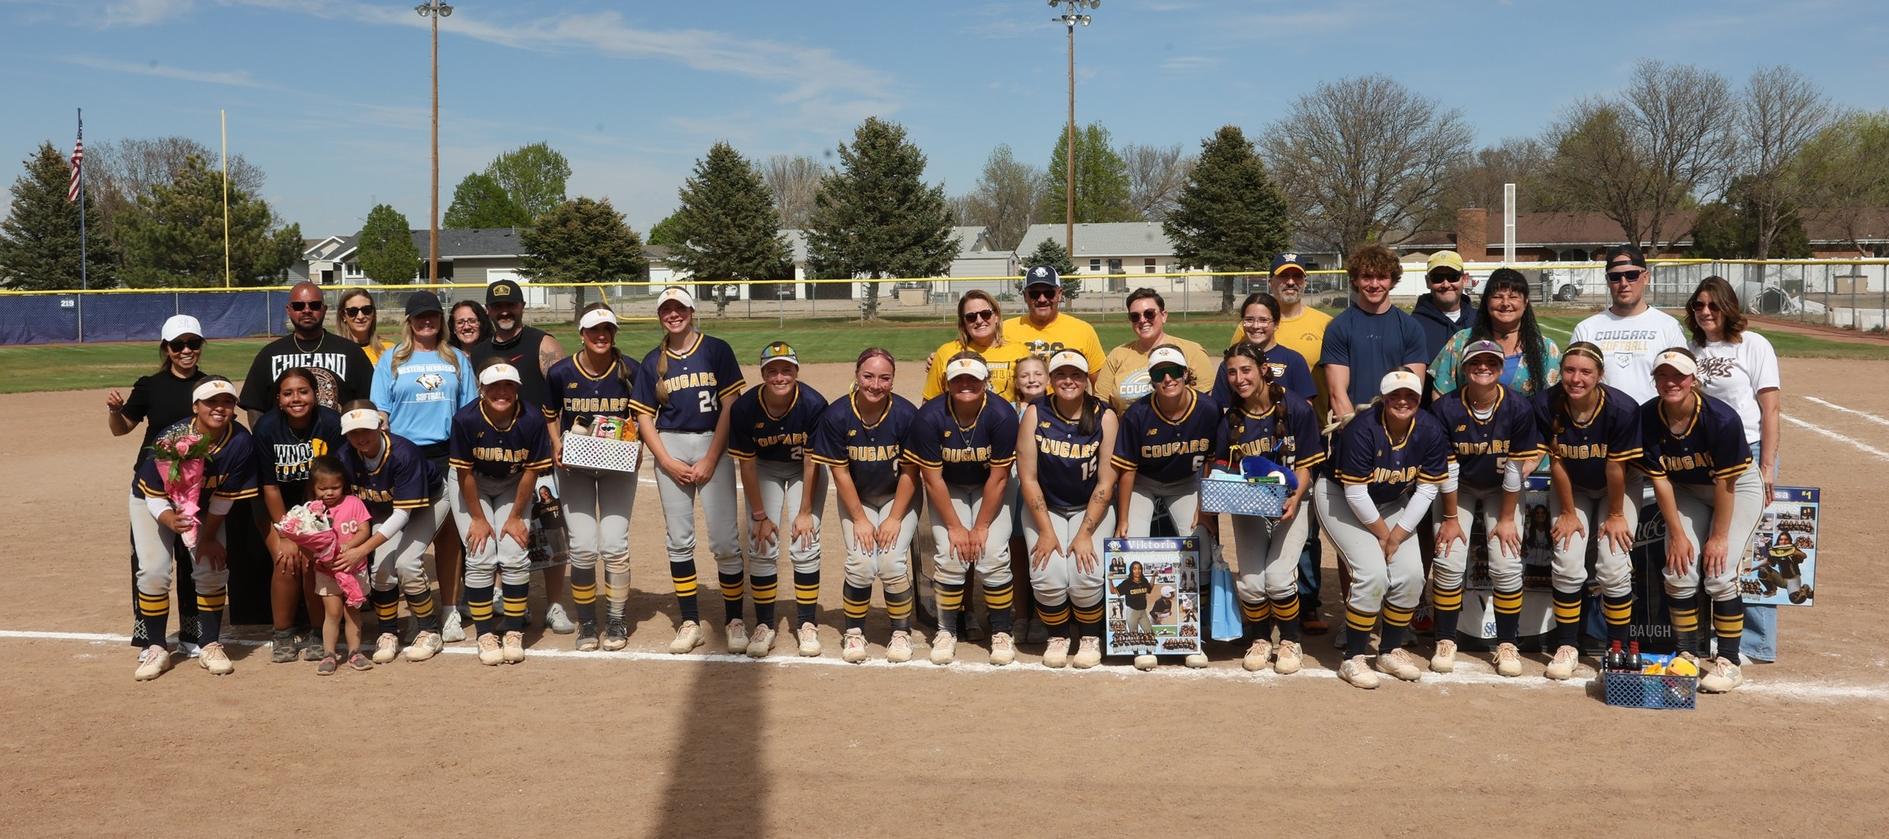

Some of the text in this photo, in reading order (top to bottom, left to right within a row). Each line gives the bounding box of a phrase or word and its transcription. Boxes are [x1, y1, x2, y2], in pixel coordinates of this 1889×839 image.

[1595, 330, 1657, 342] COUGARS
[1600, 341, 1648, 352] SOFTBALL
[272, 353, 346, 382] CHICANO
[663, 372, 718, 394] OUGARS
[1119, 384, 1155, 395] COUGA
[563, 397, 629, 412] COUGARS
[752, 432, 807, 447] OUGARS
[846, 444, 900, 462] OUGAR
[940, 445, 992, 462] OUGARS
[1141, 438, 1209, 458] COUGARS
[1081, 456, 1097, 481] 15
[1801, 490, 1812, 500] #1
[340, 520, 358, 535] CC
[1127, 539, 1193, 549] Viktoria #6
[1629, 624, 1671, 638] BAUGH
